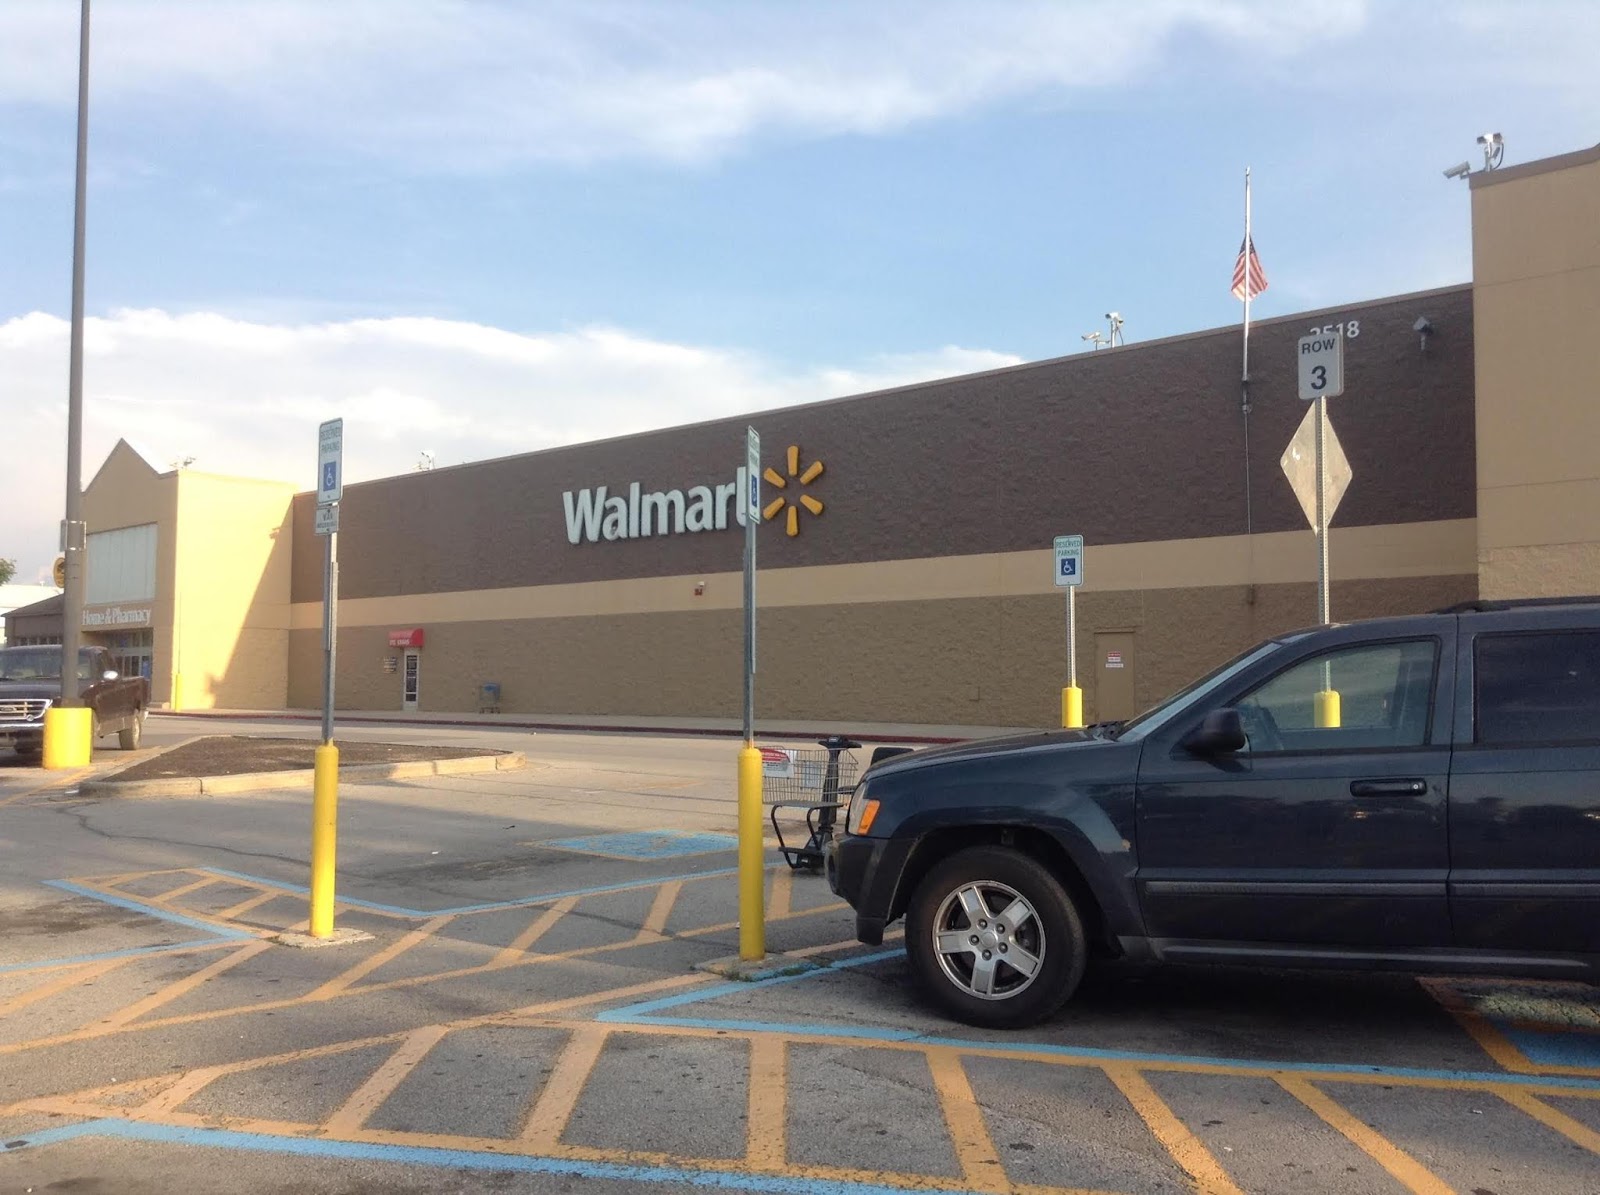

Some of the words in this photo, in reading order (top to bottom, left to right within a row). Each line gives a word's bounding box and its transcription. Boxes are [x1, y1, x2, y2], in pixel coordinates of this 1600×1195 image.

[1302, 338, 1335, 354] ROW
[1311, 365, 1327, 390] 3
[562, 466, 747, 545] Walmart
